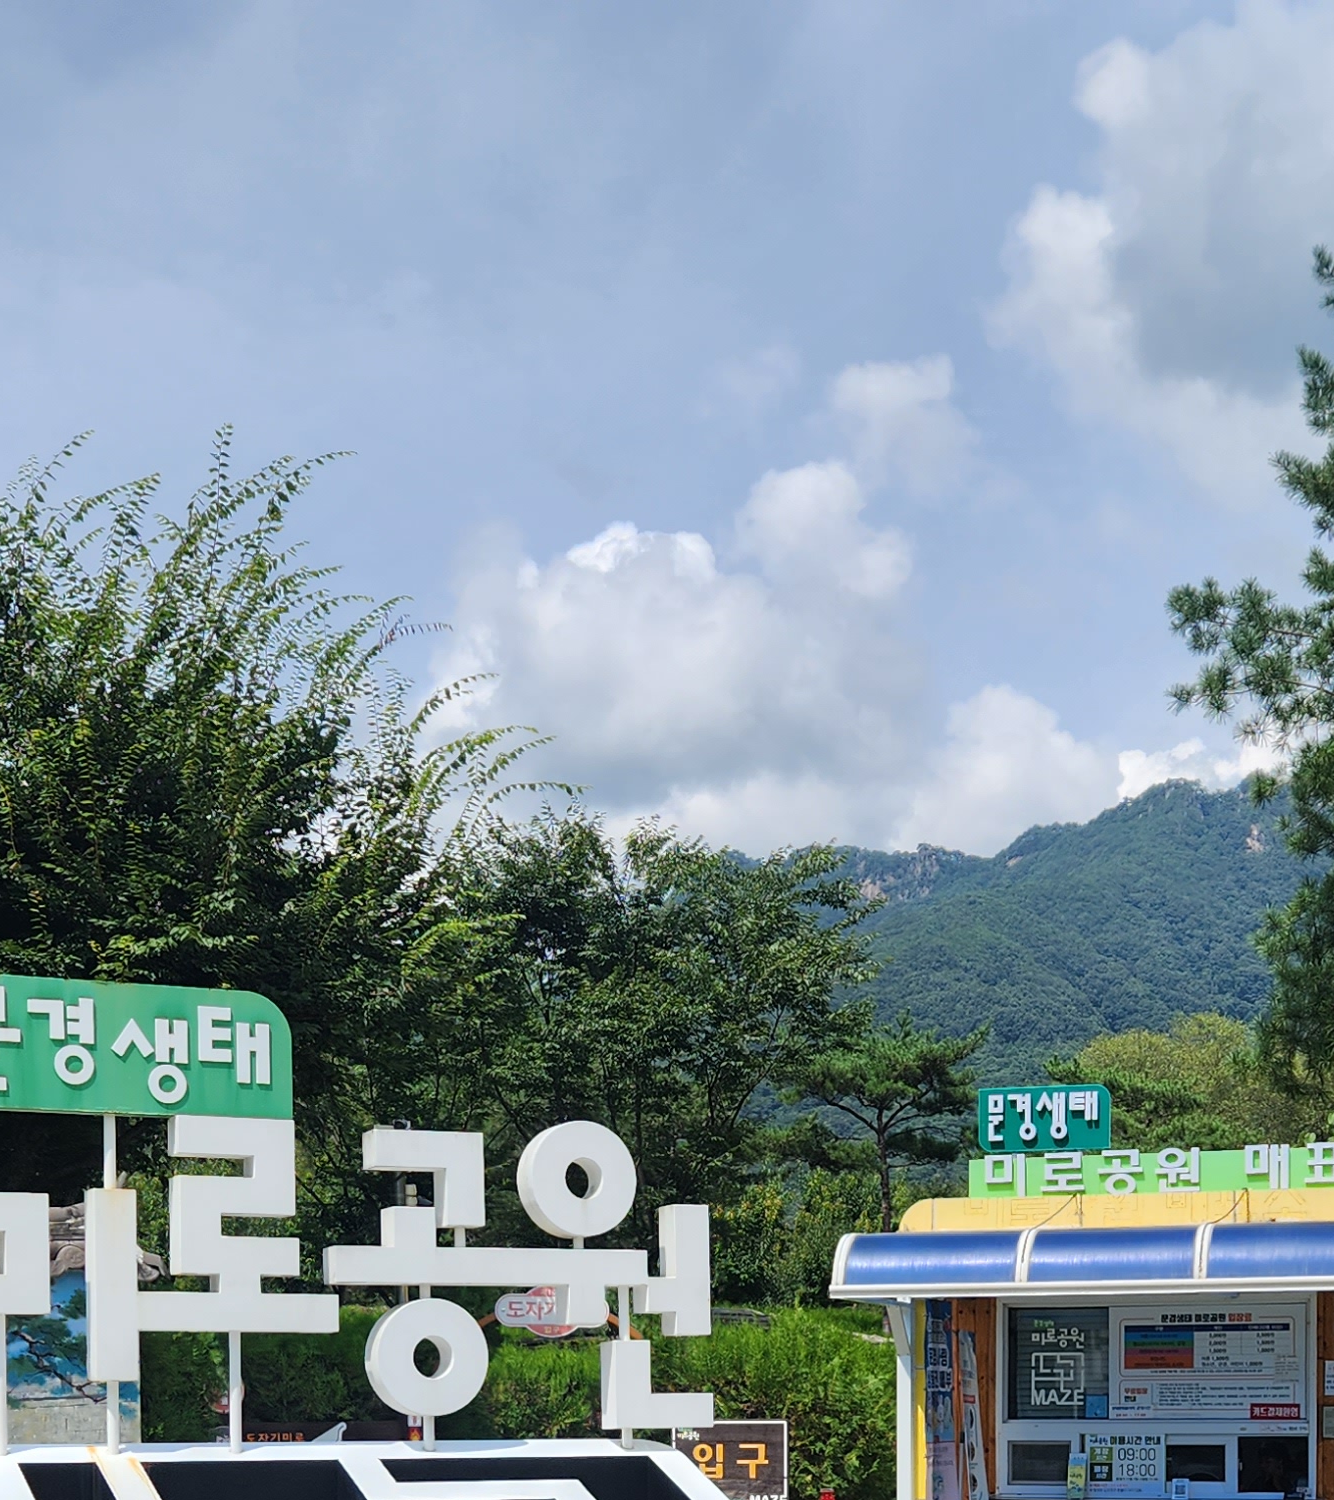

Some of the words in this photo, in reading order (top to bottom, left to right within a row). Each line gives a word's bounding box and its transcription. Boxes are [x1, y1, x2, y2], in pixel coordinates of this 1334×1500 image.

[987, 1090, 1099, 1142] 문경생태
[984, 1147, 1200, 1198] 미로공원
[1031, 1327, 1084, 1348] 미로공원
[1031, 1389, 1084, 1405] MAZE
[1109, 1436, 1143, 1445] 이용시간
[1145, 1436, 1161, 1445] 안내
[693, 1443, 769, 1479] 입구
[1118, 1448, 1156, 1461] 09:00
[1119, 1464, 1156, 1477] 18:00
